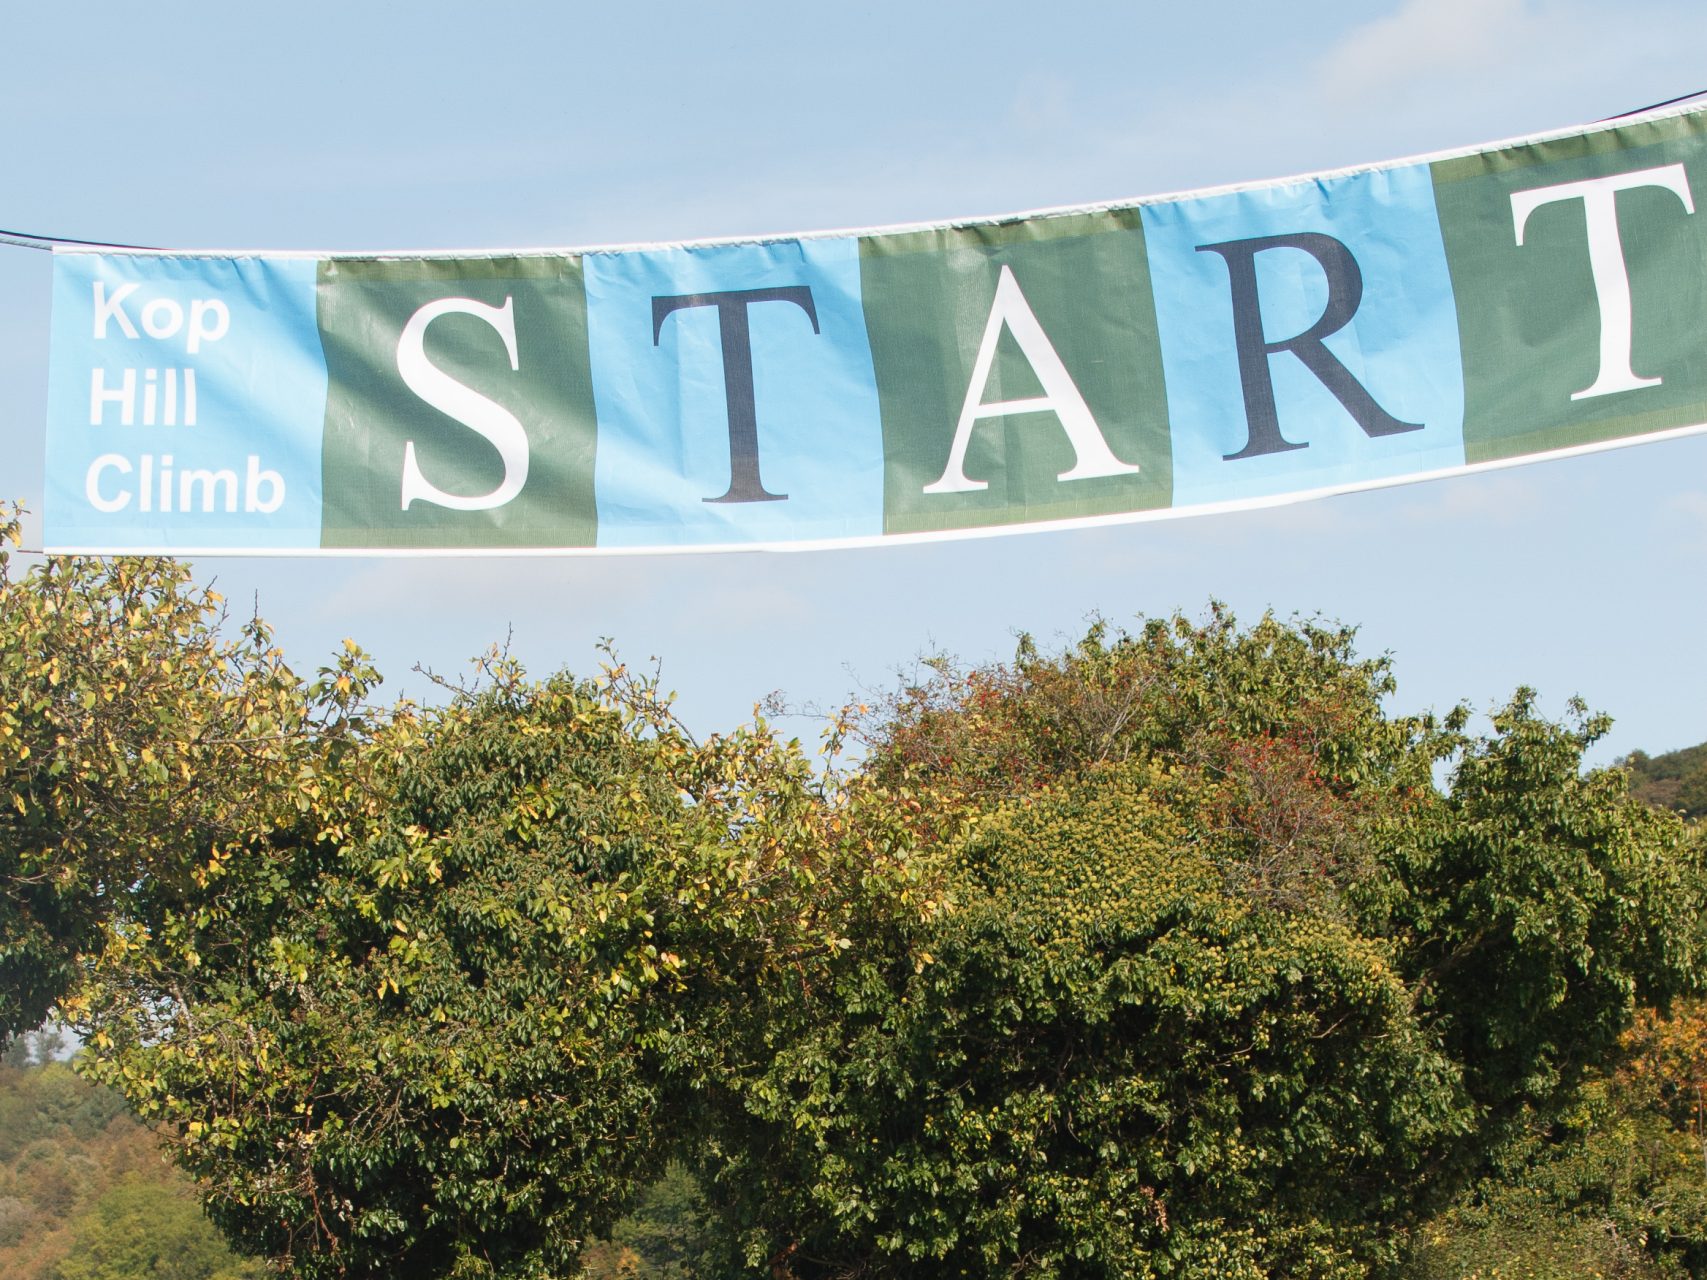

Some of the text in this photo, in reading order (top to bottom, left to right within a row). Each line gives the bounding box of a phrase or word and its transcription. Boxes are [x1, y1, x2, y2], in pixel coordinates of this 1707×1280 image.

[92, 281, 231, 354] Kop
[396, 163, 1696, 512] START
[89, 367, 197, 426] Hill
[85, 453, 287, 513] Climb
